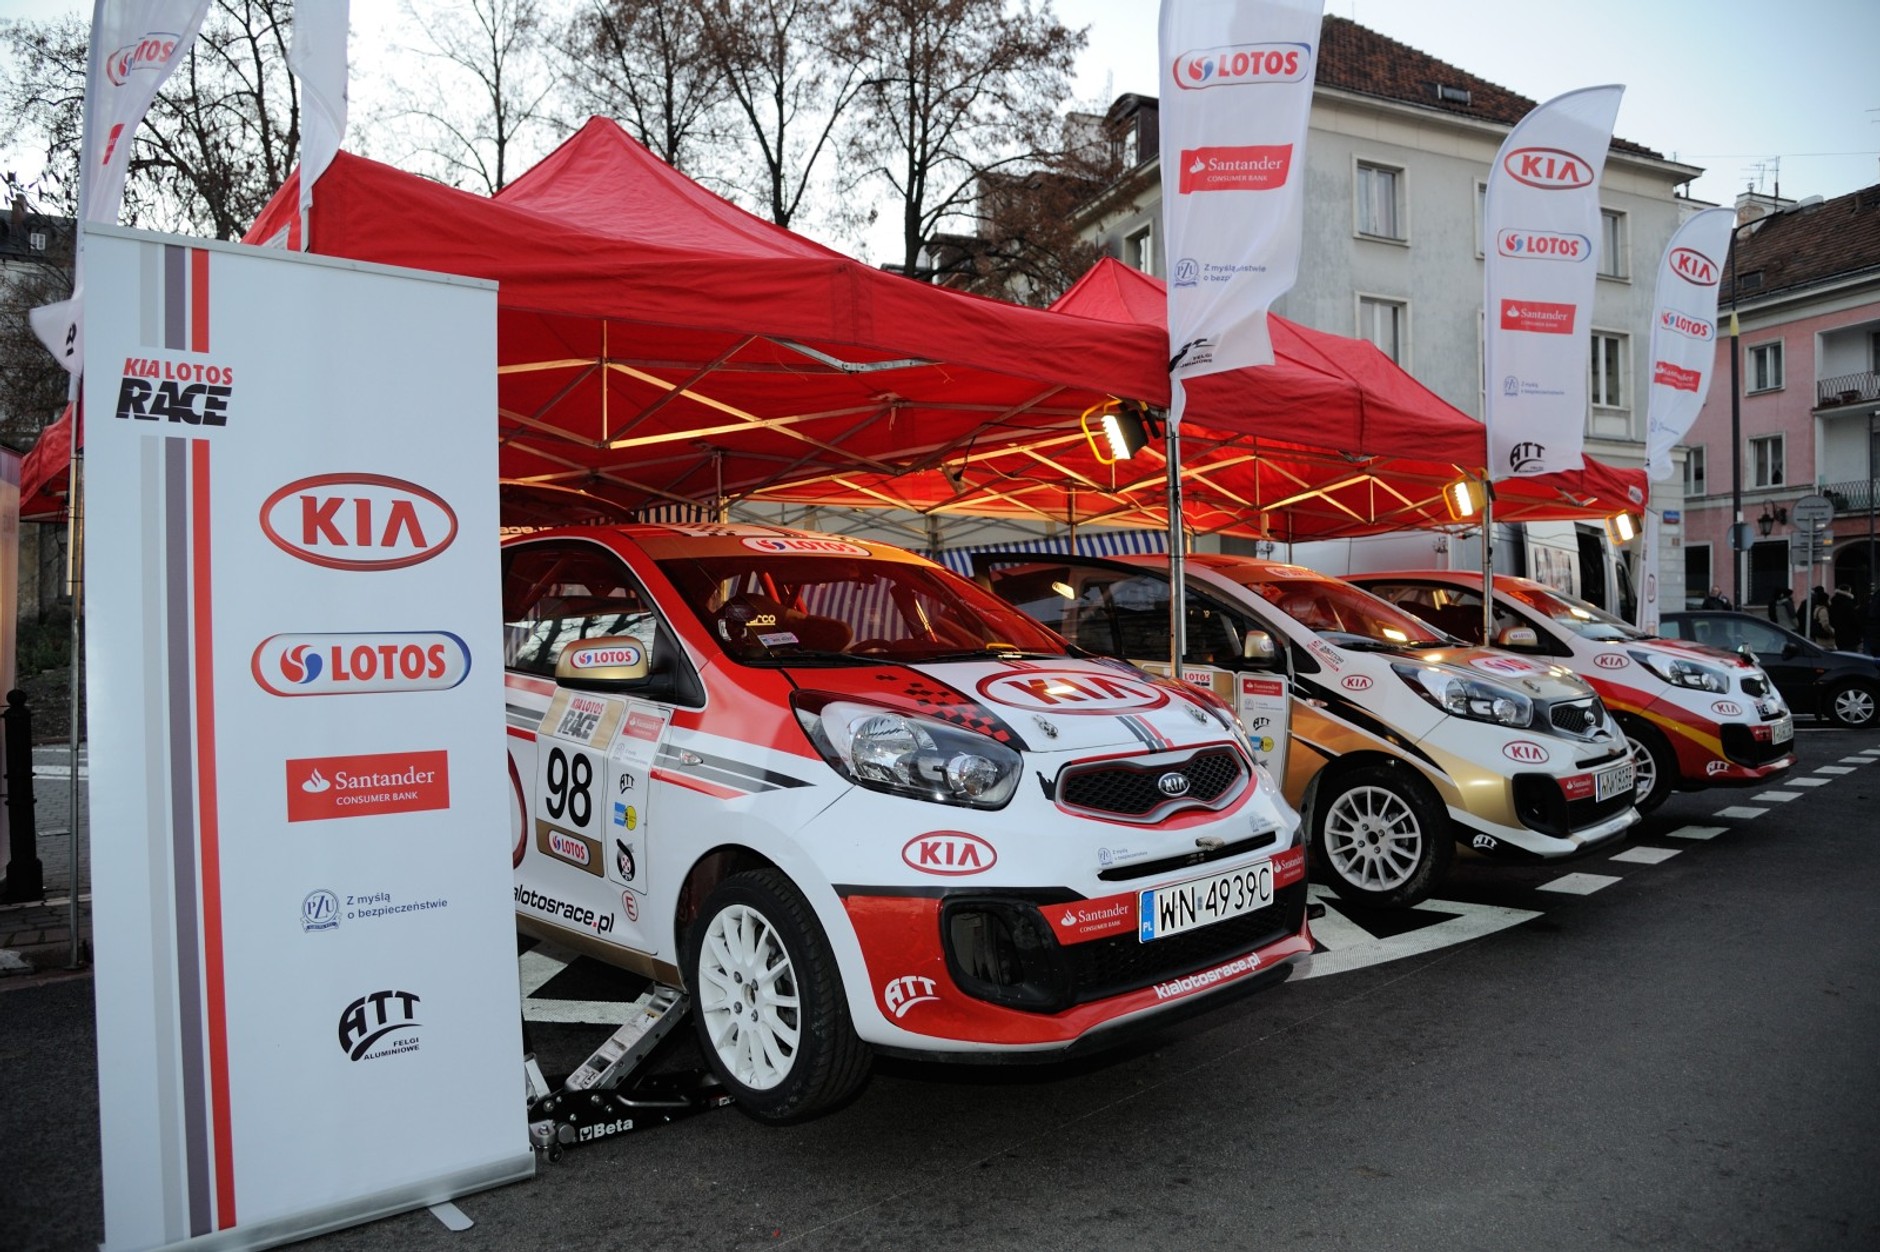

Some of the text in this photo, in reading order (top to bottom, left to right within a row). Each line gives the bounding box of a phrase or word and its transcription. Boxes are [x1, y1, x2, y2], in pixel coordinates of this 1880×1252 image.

[1218, 51, 1298, 77] LOTOS
[1208, 156, 1283, 171] Santander
[1521, 154, 1580, 183] KIA
[1527, 236, 1579, 257] LOTOS
[1678, 253, 1711, 281] KIA
[1520, 308, 1568, 321] Santander
[1675, 315, 1708, 336] LOTOS
[123, 357, 233, 386] KIA LOTOS
[115, 377, 232, 427] RACE
[1510, 441, 1546, 468] ATT
[300, 495, 428, 549] KIA
[784, 540, 858, 553] LOTOS
[331, 644, 446, 681] LOTOS
[594, 651, 632, 664] LOTOS
[1600, 656, 1623, 667] KIA
[1184, 673, 1210, 682] LOTOS
[1347, 679, 1368, 688] KIA
[1002, 677, 1153, 705] KIA
[570, 698, 605, 715] KIA LOTOS
[1716, 704, 1739, 714] KIA
[558, 709, 600, 740] RACE
[1252, 716, 1271, 728] ATT
[1511, 746, 1543, 760] KIA
[1706, 760, 1730, 773] ATT
[335, 765, 435, 790] Santander
[546, 747, 593, 828] 98
[620, 773, 636, 790] ATT
[1163, 777, 1187, 793] KIA
[336, 791, 418, 806] CONSUMER BANK
[561, 839, 585, 860] LOTOS
[1472, 833, 1498, 848] ATT
[920, 841, 981, 867] KIA
[307, 895, 335, 919] PZU
[346, 892, 391, 905] Z myślą
[347, 898, 448, 919] o bezpieczeństwie
[625, 896, 636, 917] E
[1142, 867, 1270, 933] PL WN 4939C
[1078, 903, 1129, 923] Santander
[1153, 952, 1261, 999] kialotosrace.pl
[884, 975, 937, 1013] ATT
[338, 990, 421, 1054] ATT
[363, 1044, 420, 1061] ALUMINIOWE
[393, 1037, 420, 1047] FELGI
[593, 1119, 634, 1138] Beta
